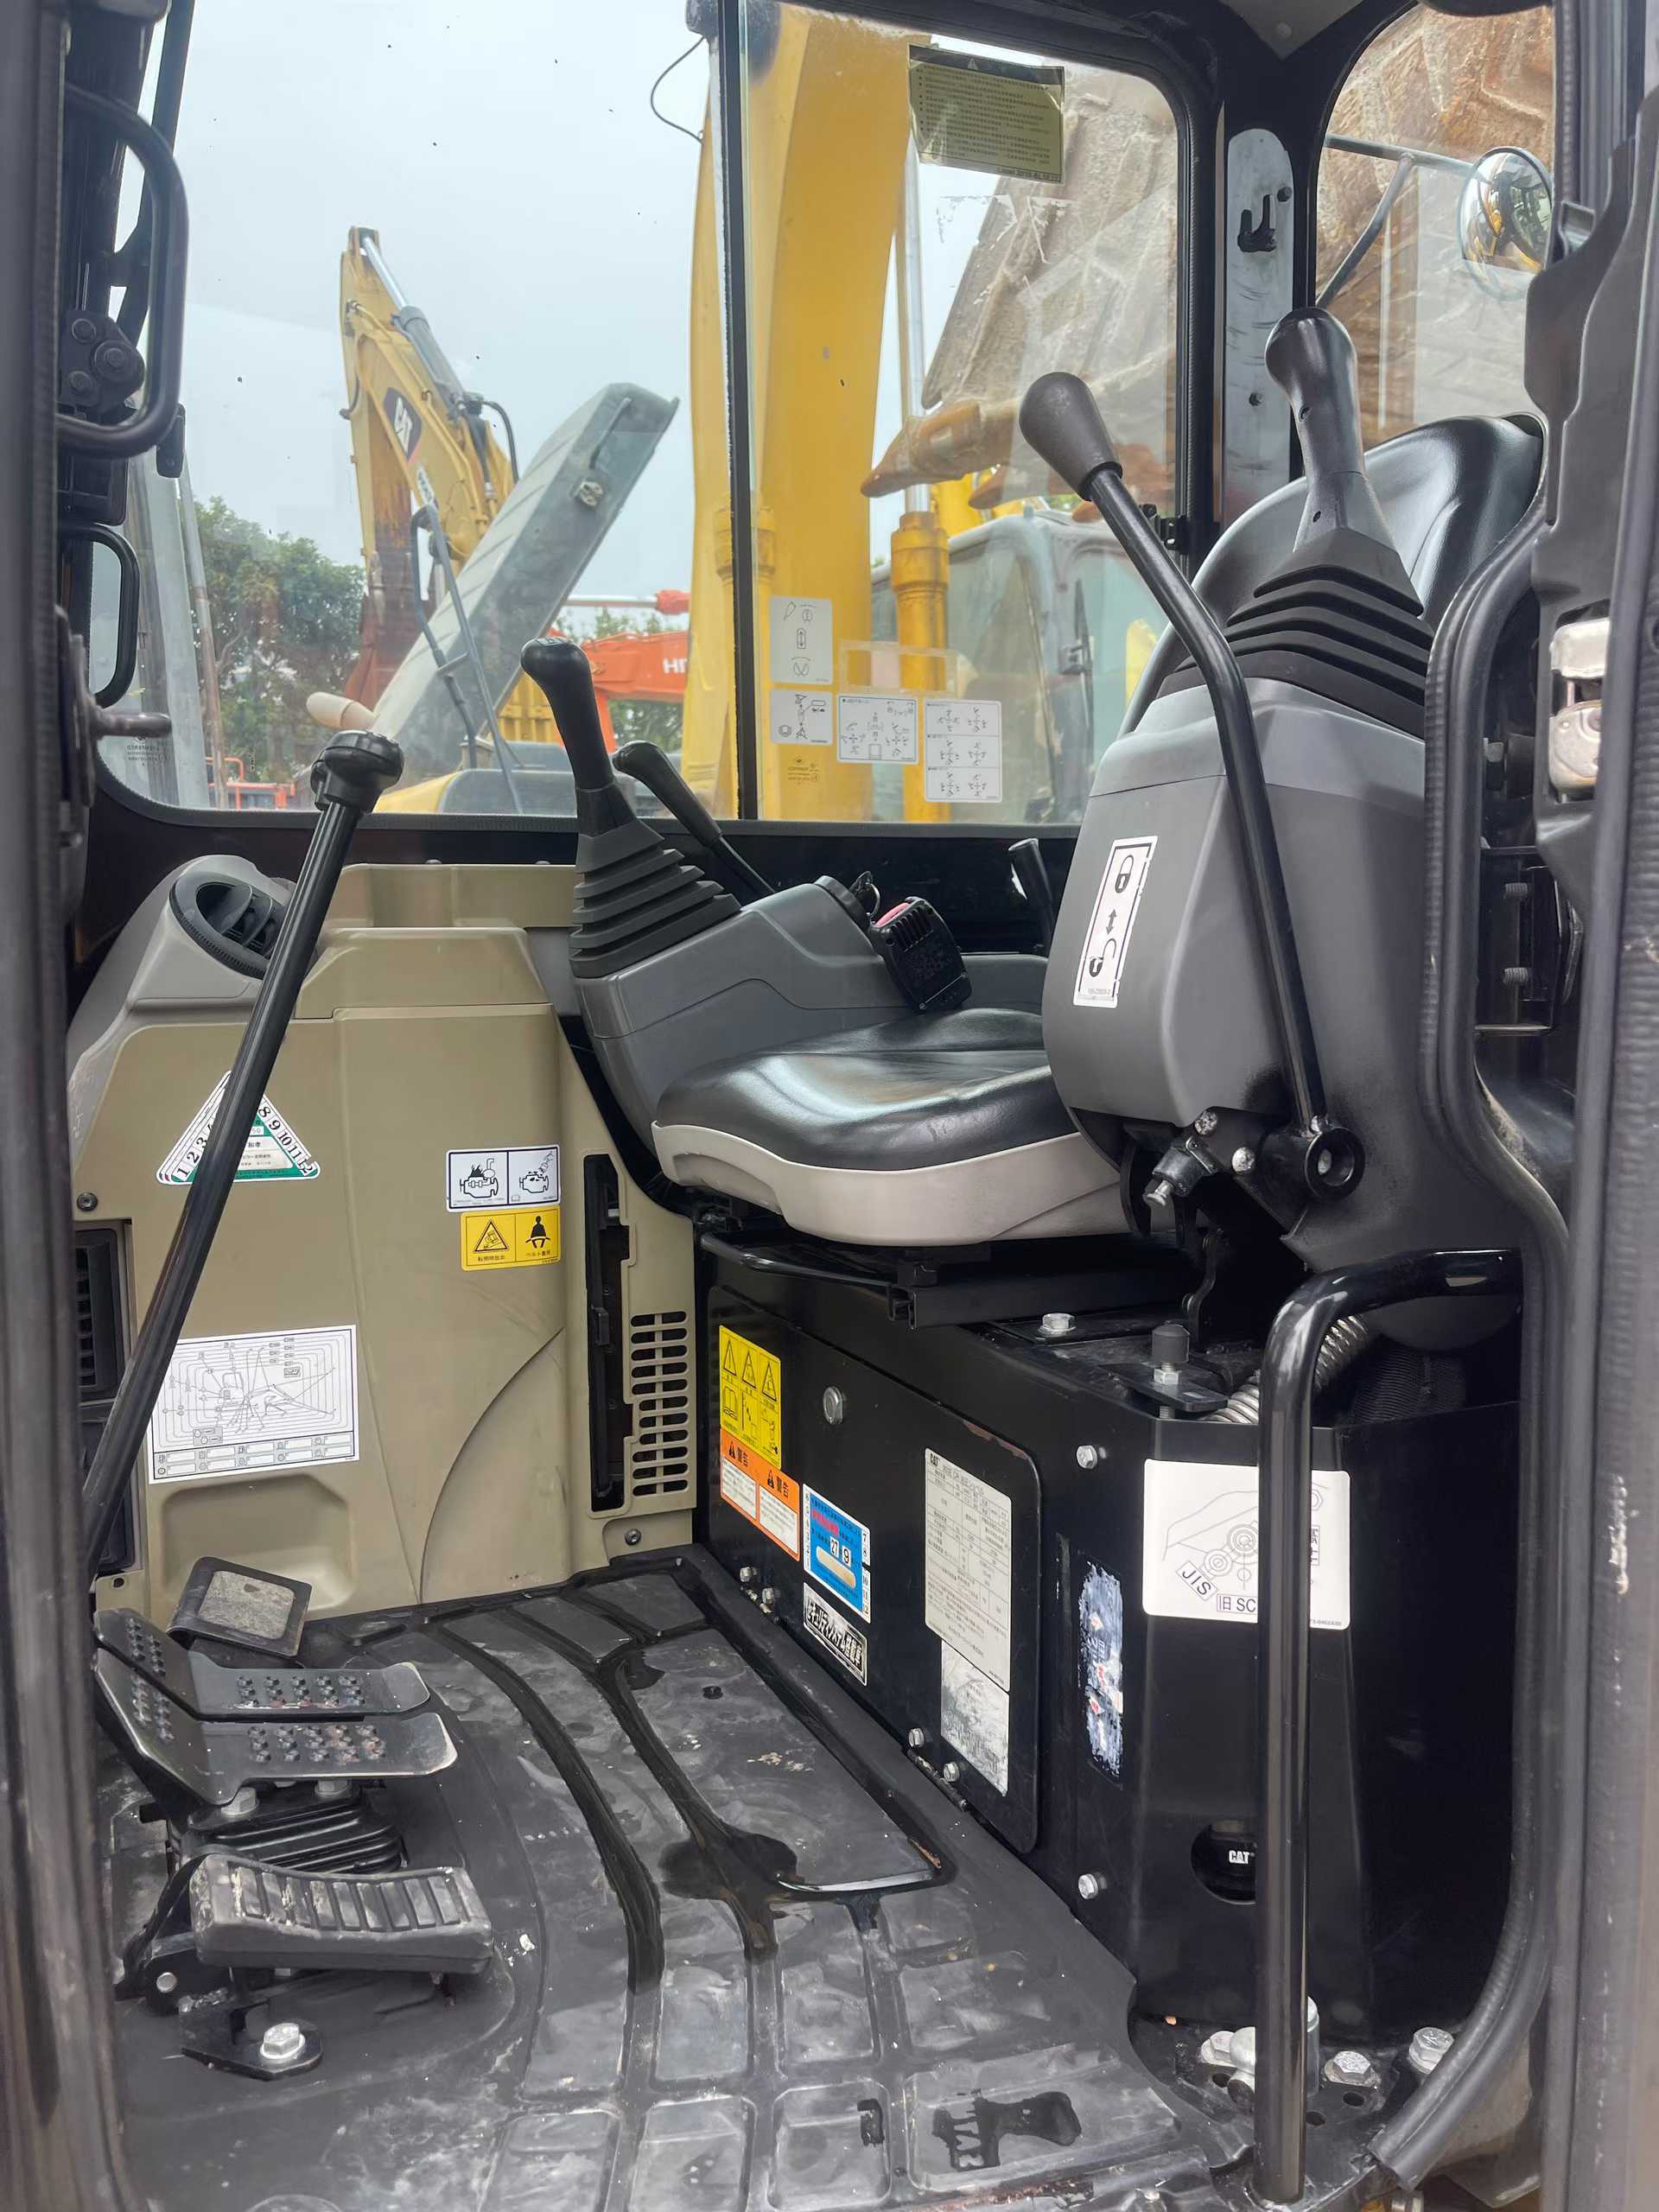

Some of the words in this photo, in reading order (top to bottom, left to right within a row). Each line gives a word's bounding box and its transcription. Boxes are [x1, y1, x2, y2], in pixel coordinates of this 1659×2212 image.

[258, 1106, 271, 1118] 8
[269, 1120, 281, 1131] 9
[196, 1137, 208, 1149] 3
[278, 1131, 292, 1146] 10
[187, 1151, 200, 1164] 2
[288, 1145, 302, 1160] 11
[177, 1167, 190, 1178] 1
[297, 1158, 314, 1174] 12
[843, 1548, 849, 1565] 9
[1182, 1567, 1212, 1596] JIS
[1228, 1849, 1250, 1865] CAT
